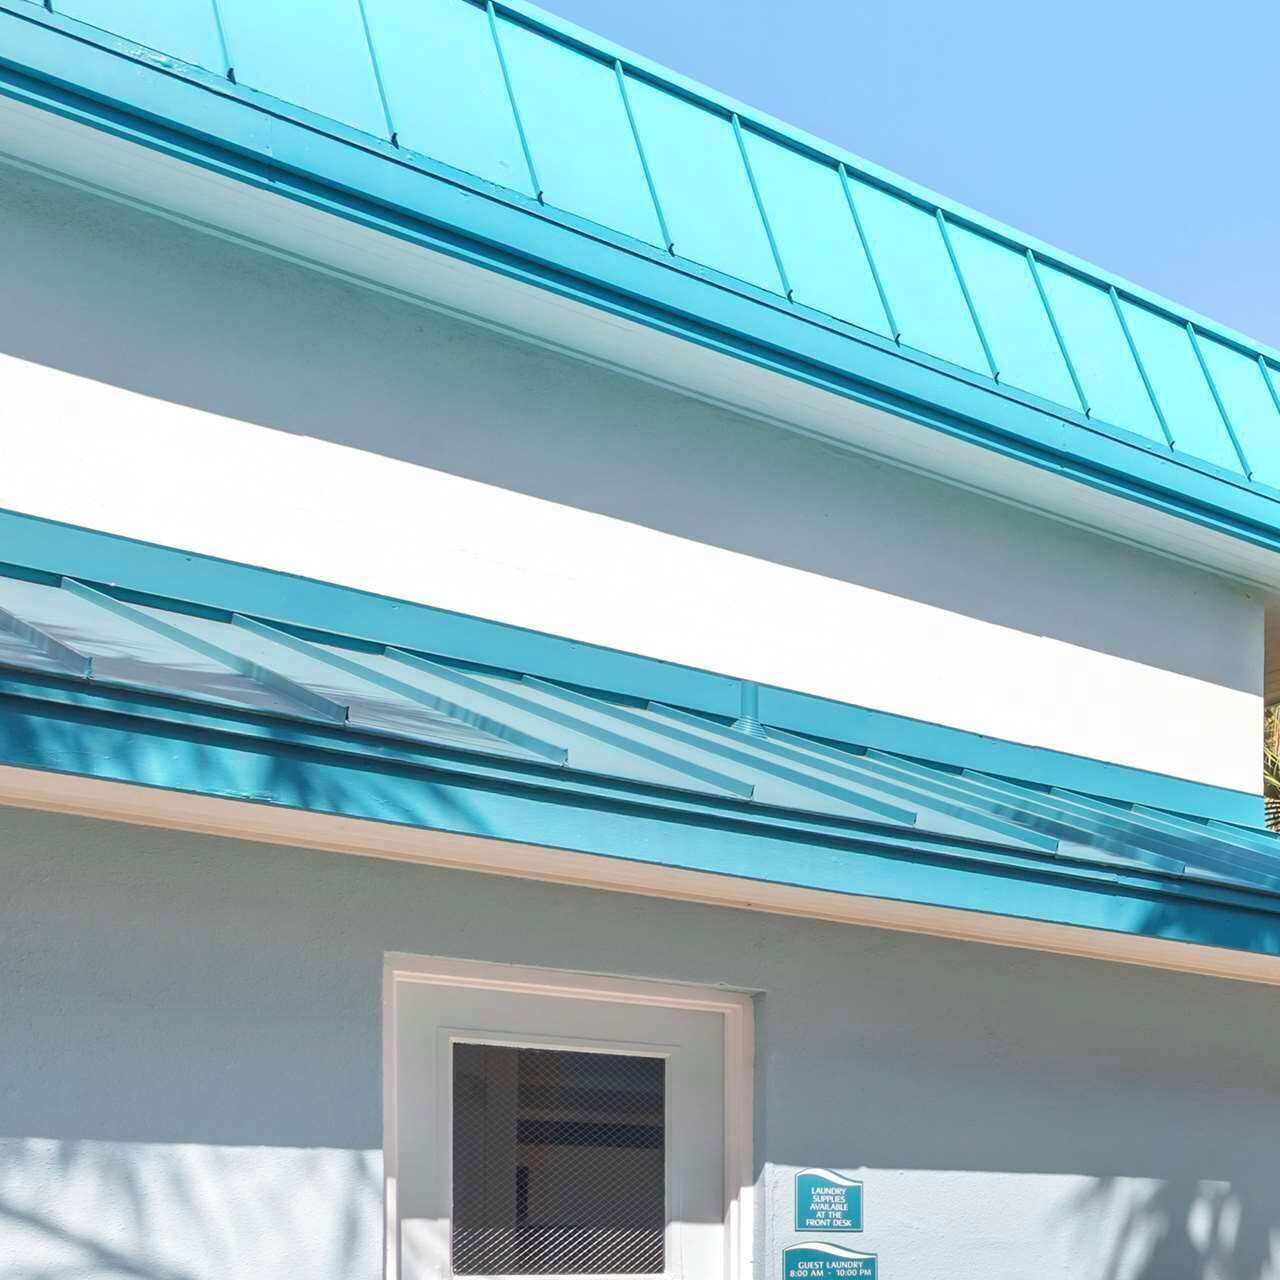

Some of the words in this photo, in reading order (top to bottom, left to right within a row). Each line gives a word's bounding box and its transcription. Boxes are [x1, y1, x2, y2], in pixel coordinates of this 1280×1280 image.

[810, 1203, 848, 1211] AVAILABLE
[798, 1261, 824, 1269] GUEST
[826, 1261, 863, 1269] LAUNDRY
